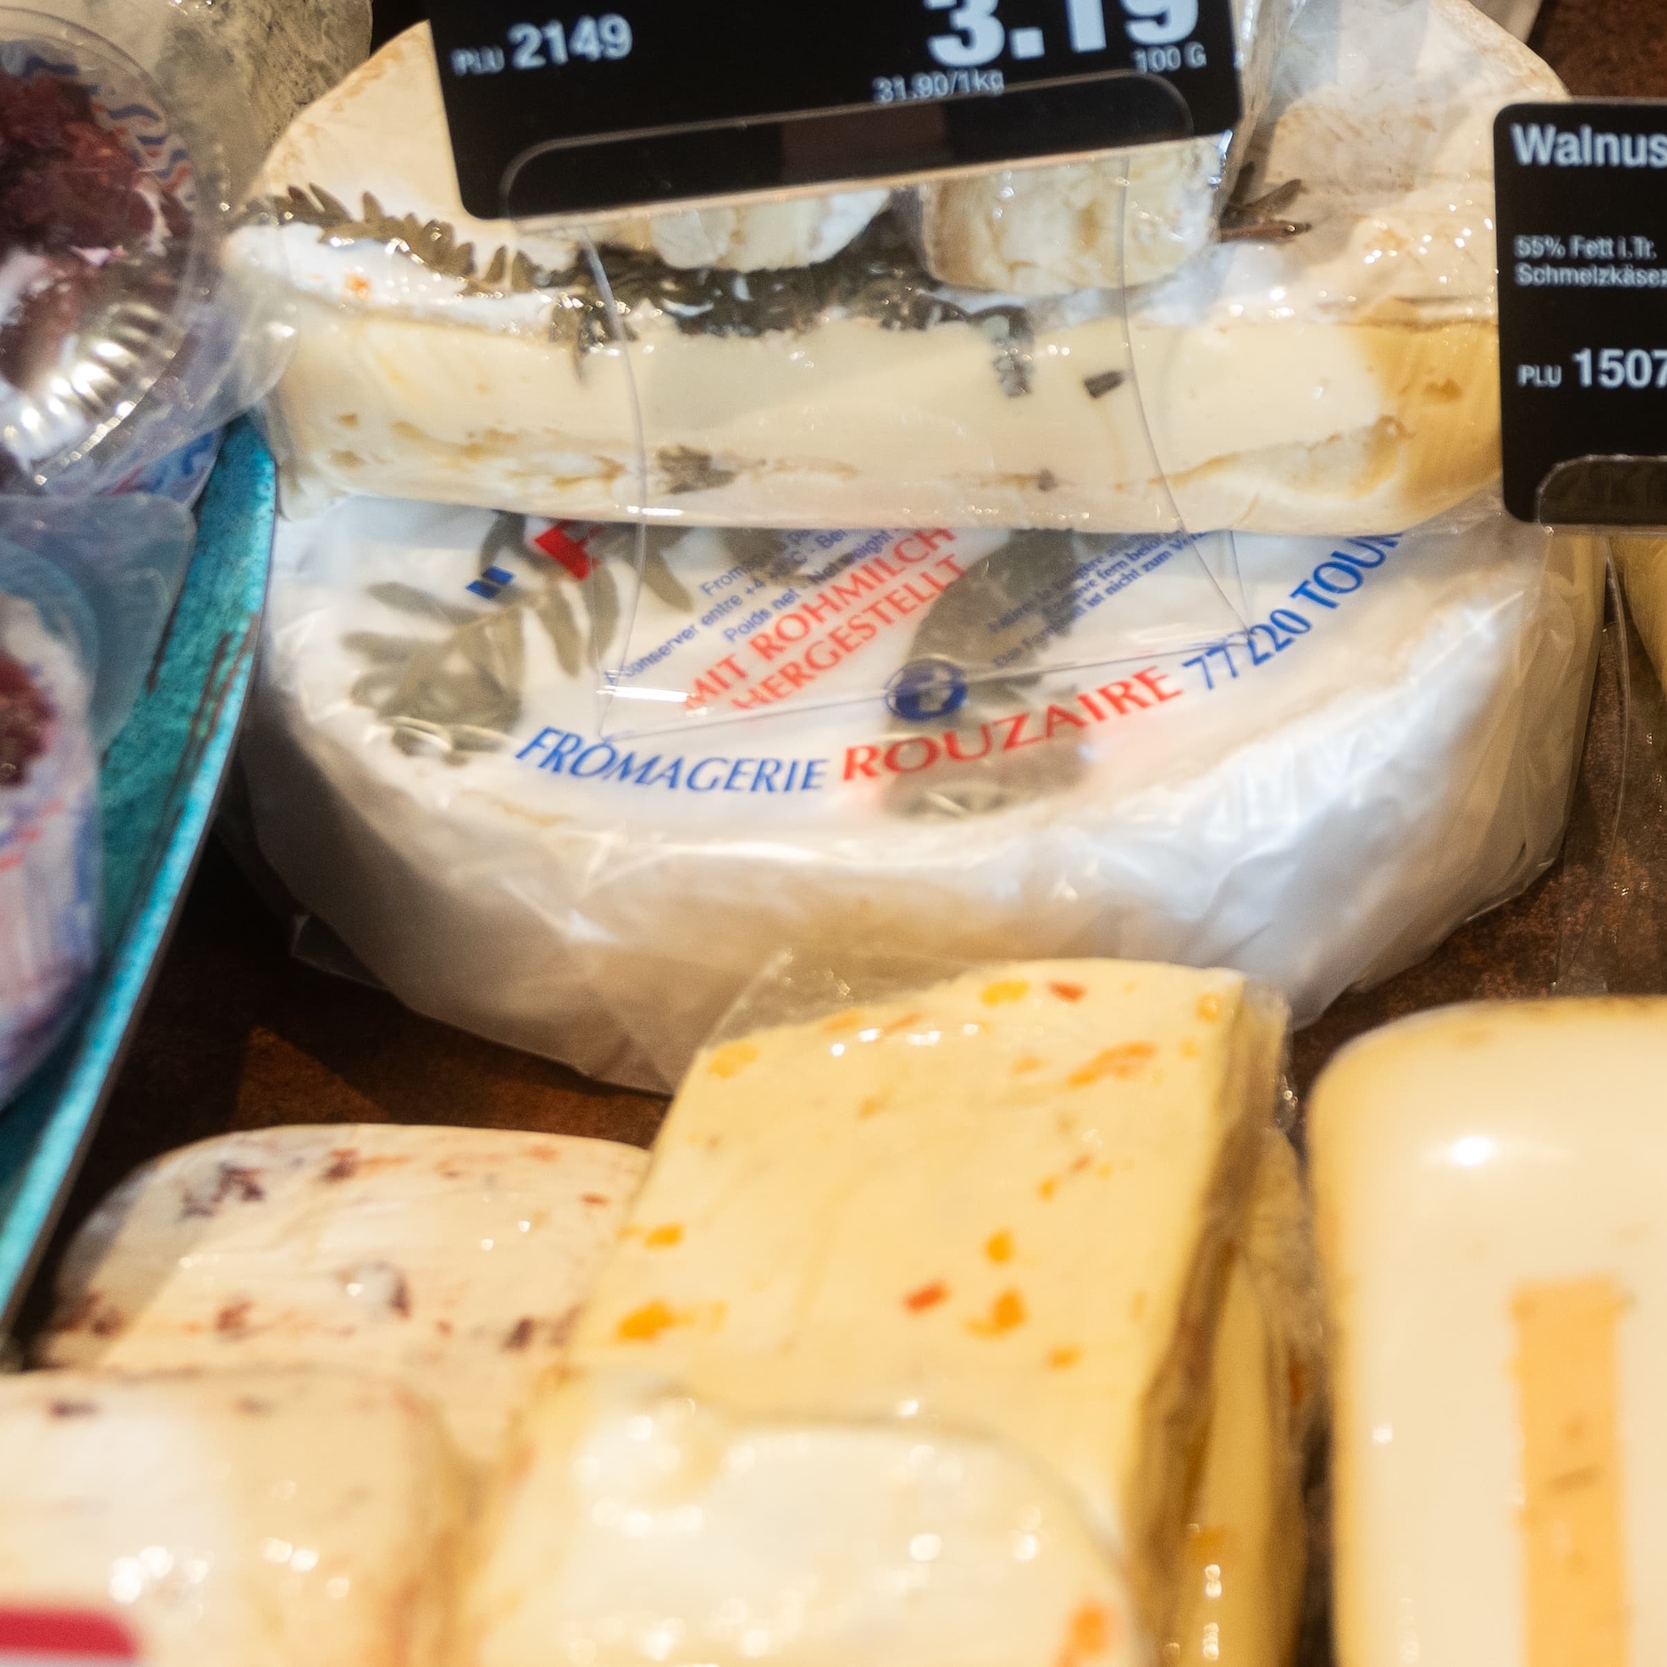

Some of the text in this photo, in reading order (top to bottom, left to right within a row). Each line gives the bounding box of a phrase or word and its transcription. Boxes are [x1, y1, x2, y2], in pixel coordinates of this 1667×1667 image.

[452, 14, 633, 74] PLU 2149
[1134, 43, 1207, 74] 100 G
[877, 69, 1005, 103] 31.90/1kg
[1514, 235, 1657, 259] 55% Fett i.Tr.
[1518, 364, 1562, 387] PLU
[684, 653, 749, 710] MIT
[749, 528, 957, 661] ROHMILCH
[700, 593, 743, 628] entre
[723, 588, 801, 644] Poids net
[731, 553, 967, 710] HERGESTELLT
[515, 607, 1313, 794] FROMAGERIE ROUZAIRE 77220
